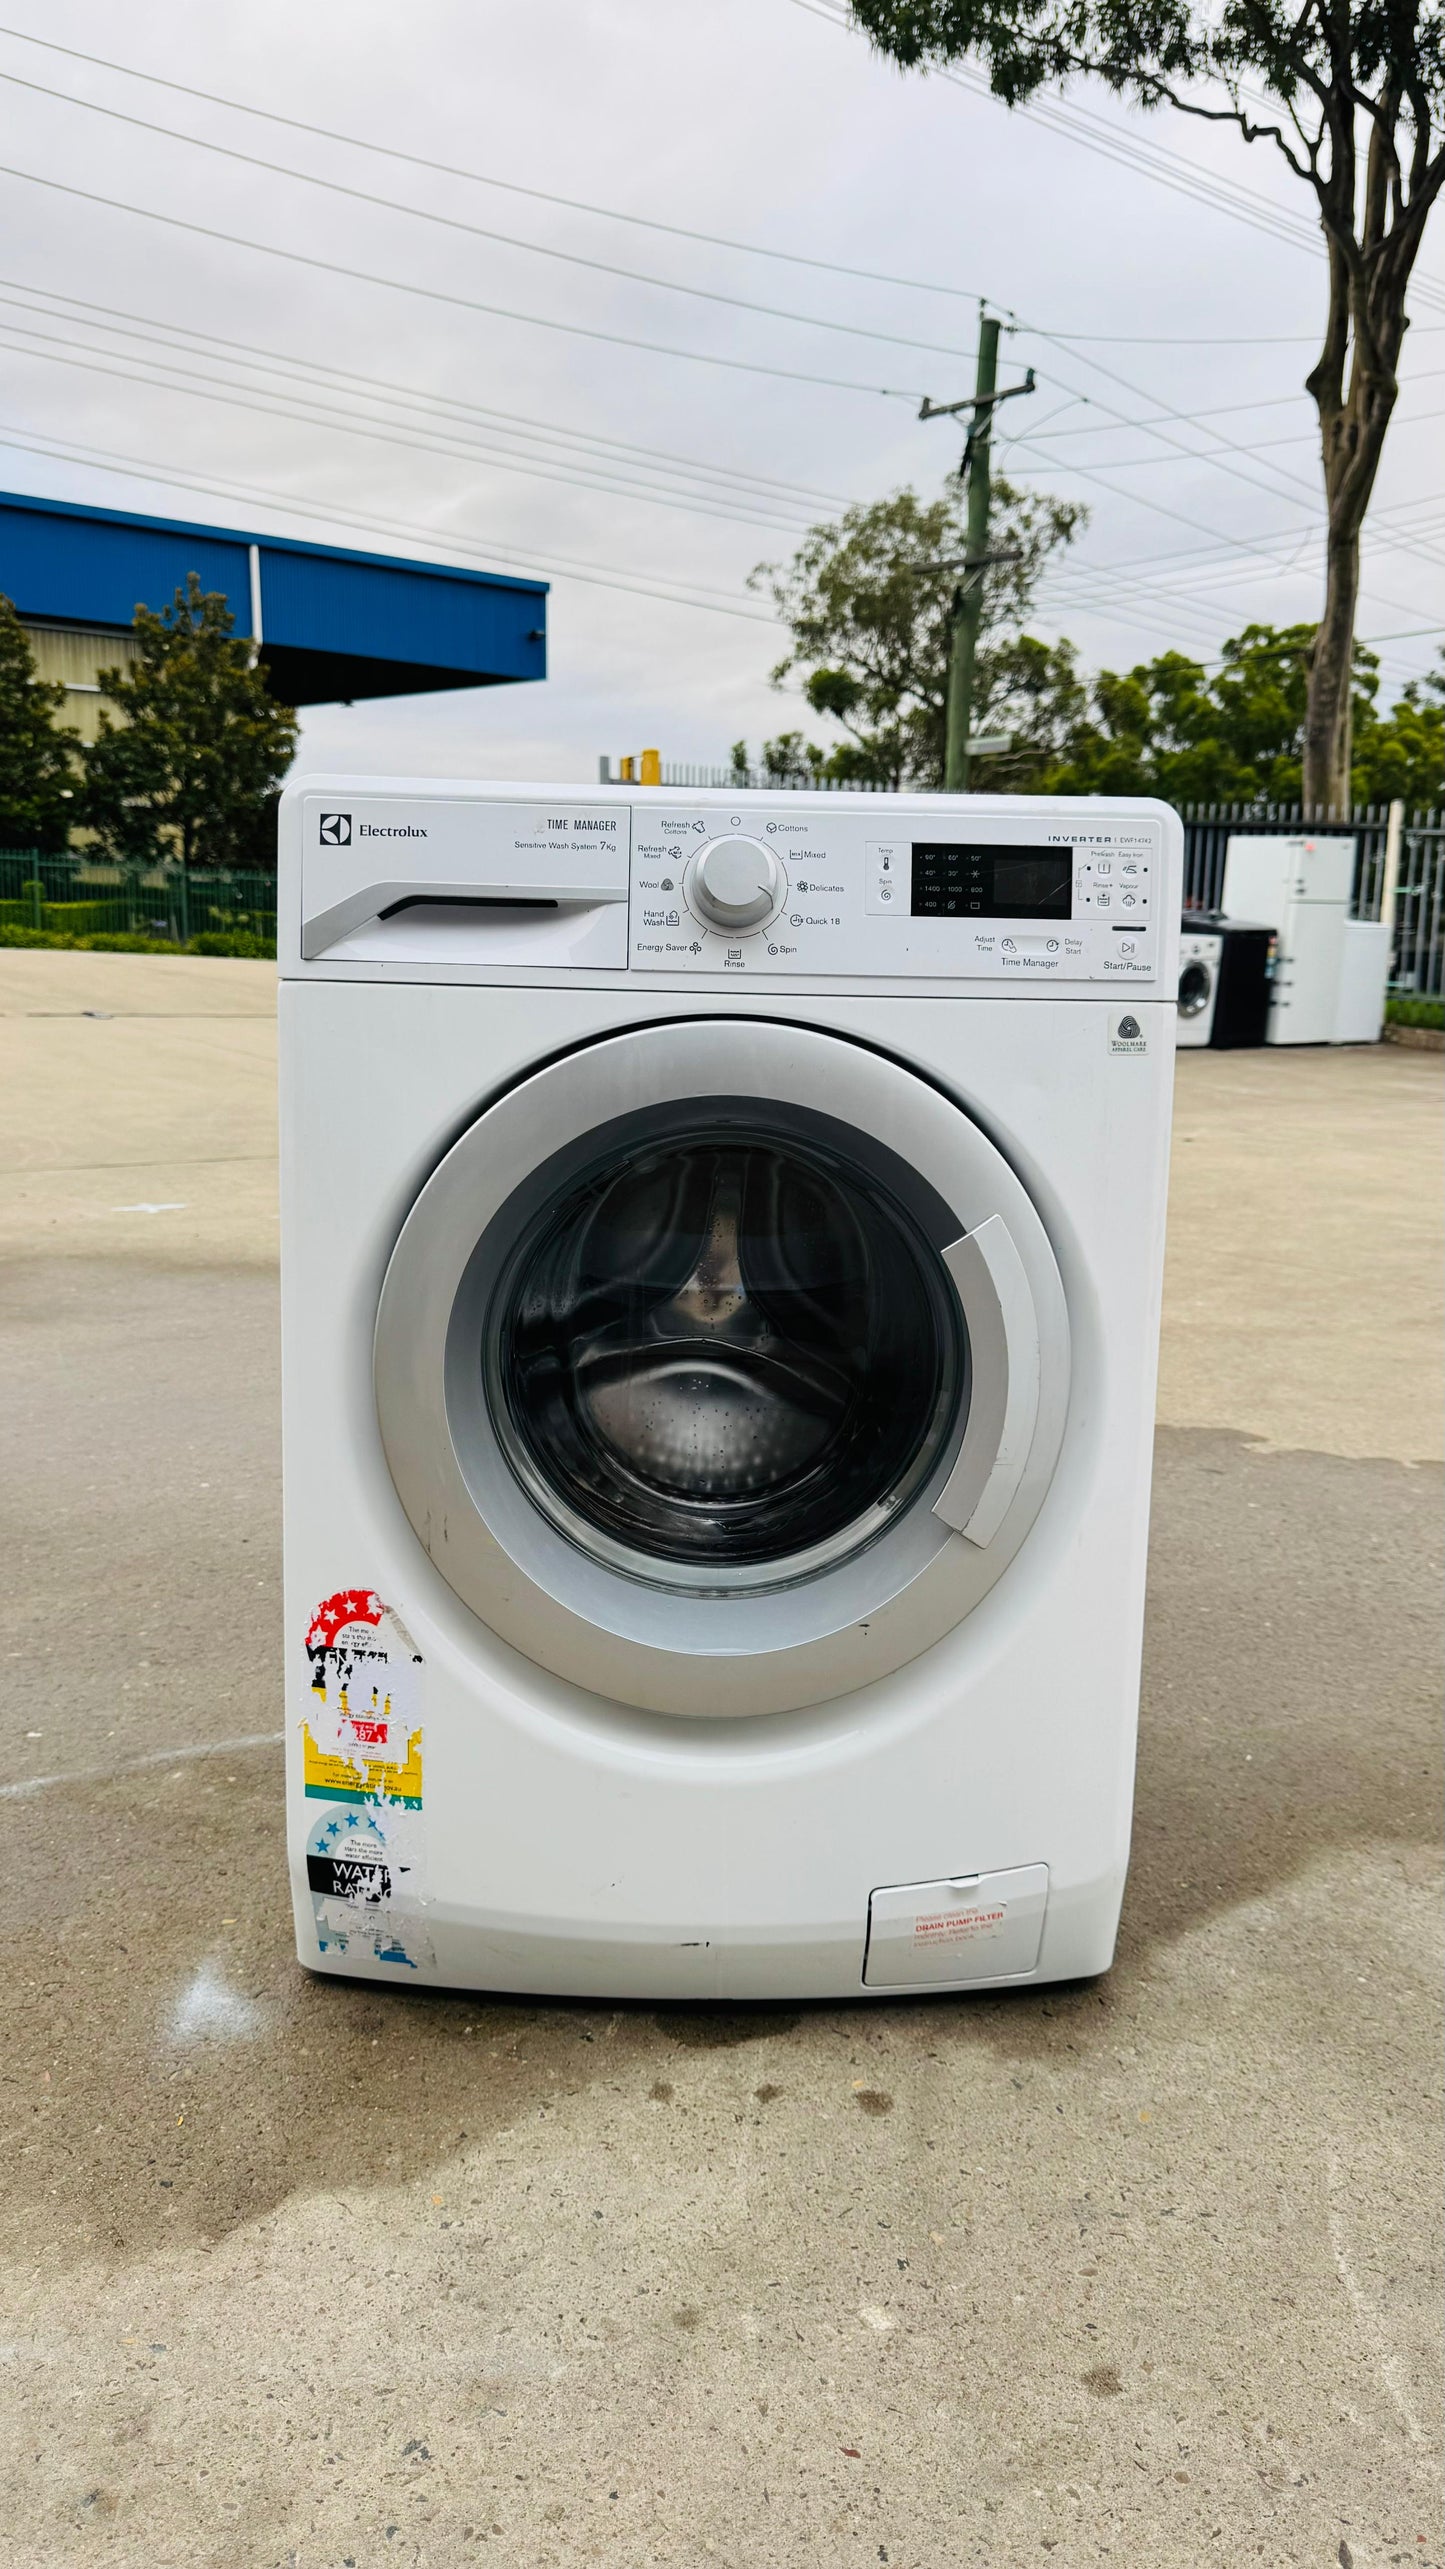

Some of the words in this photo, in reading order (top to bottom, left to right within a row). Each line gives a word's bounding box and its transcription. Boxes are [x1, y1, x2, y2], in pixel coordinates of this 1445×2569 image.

[547, 819, 569, 830] TIME
[573, 819, 617, 832] MANAGER
[661, 820, 691, 829] Refresh
[778, 825, 808, 833] Cottons
[359, 824, 428, 838] Electrolux
[1048, 835, 1112, 843] INVERTER
[514, 841, 546, 849] Sensitive
[548, 841, 569, 850] Wash
[570, 842, 598, 852] System
[637, 845, 667, 853] Refresh
[804, 851, 826, 859] Mixed
[1118, 851, 1132, 859] Easy
[639, 881, 660, 889] Wool
[878, 878, 892, 886] Spin
[809, 885, 844, 893] Delicates
[643, 910, 665, 918] Hand
[643, 918, 665, 927] Wash
[805, 917, 828, 926] Quick
[974, 935, 996, 945] Adjust
[1064, 938, 1083, 948] Delay
[637, 944, 664, 952] Energy
[665, 943, 688, 952] Saver
[779, 945, 798, 954] Spin
[977, 944, 993, 953] Time
[1065, 947, 1082, 955] Start
[724, 960, 745, 968] Rinse
[1001, 957, 1021, 967] Time
[1022, 958, 1059, 969] Manager
[1103, 961, 1152, 972] Start/Pause
[915, 1922, 944, 1932] DRAIN
[946, 1917, 973, 1927] PUMP
[974, 1911, 1004, 1922] FILTER
